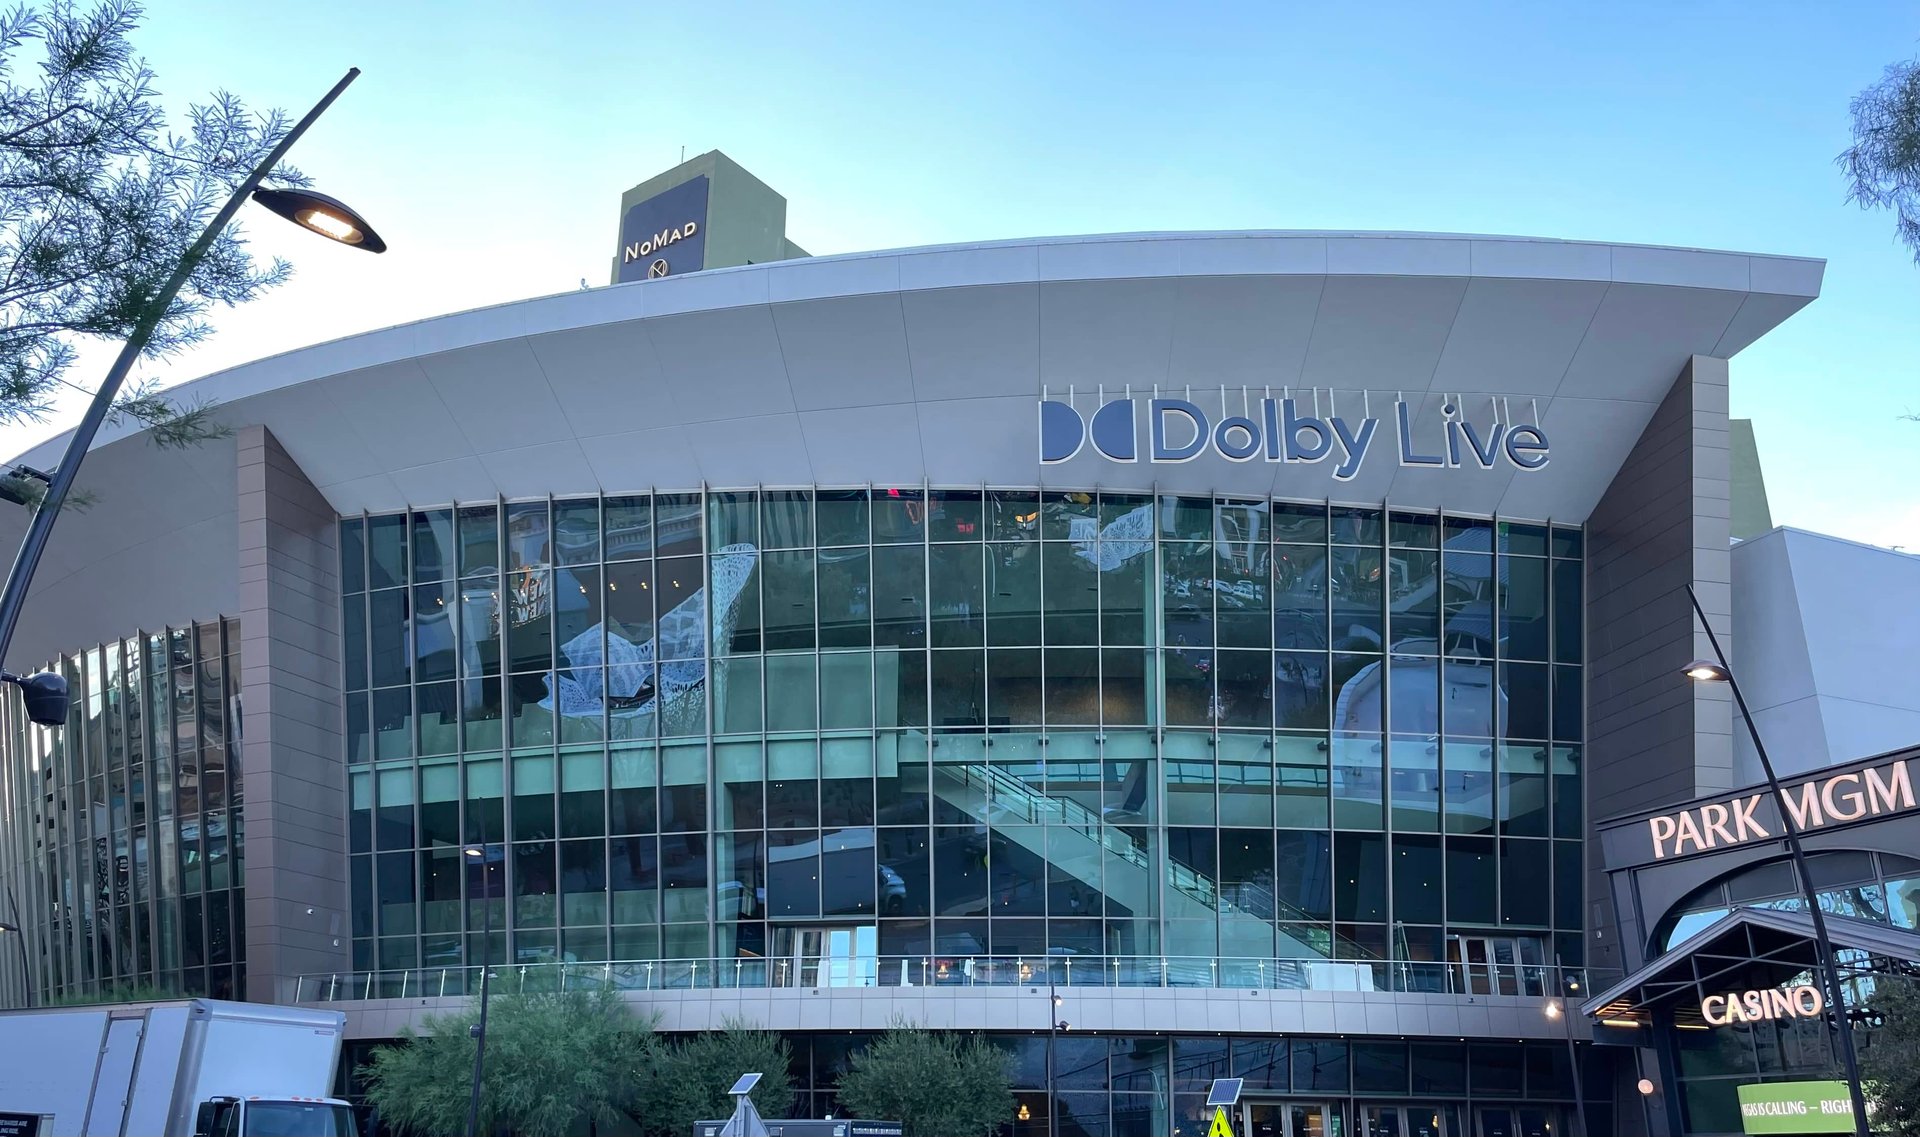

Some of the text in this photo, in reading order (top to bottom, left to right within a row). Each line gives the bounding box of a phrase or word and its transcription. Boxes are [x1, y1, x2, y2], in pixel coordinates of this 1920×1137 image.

[1150, 398, 1550, 482] Dolby Live
[1649, 760, 1917, 859] PARK MGM
[1701, 985, 1823, 1025] CASINO
[1765, 1101, 1807, 1115] CALLING
[1820, 1099, 1853, 1114] RIGH
